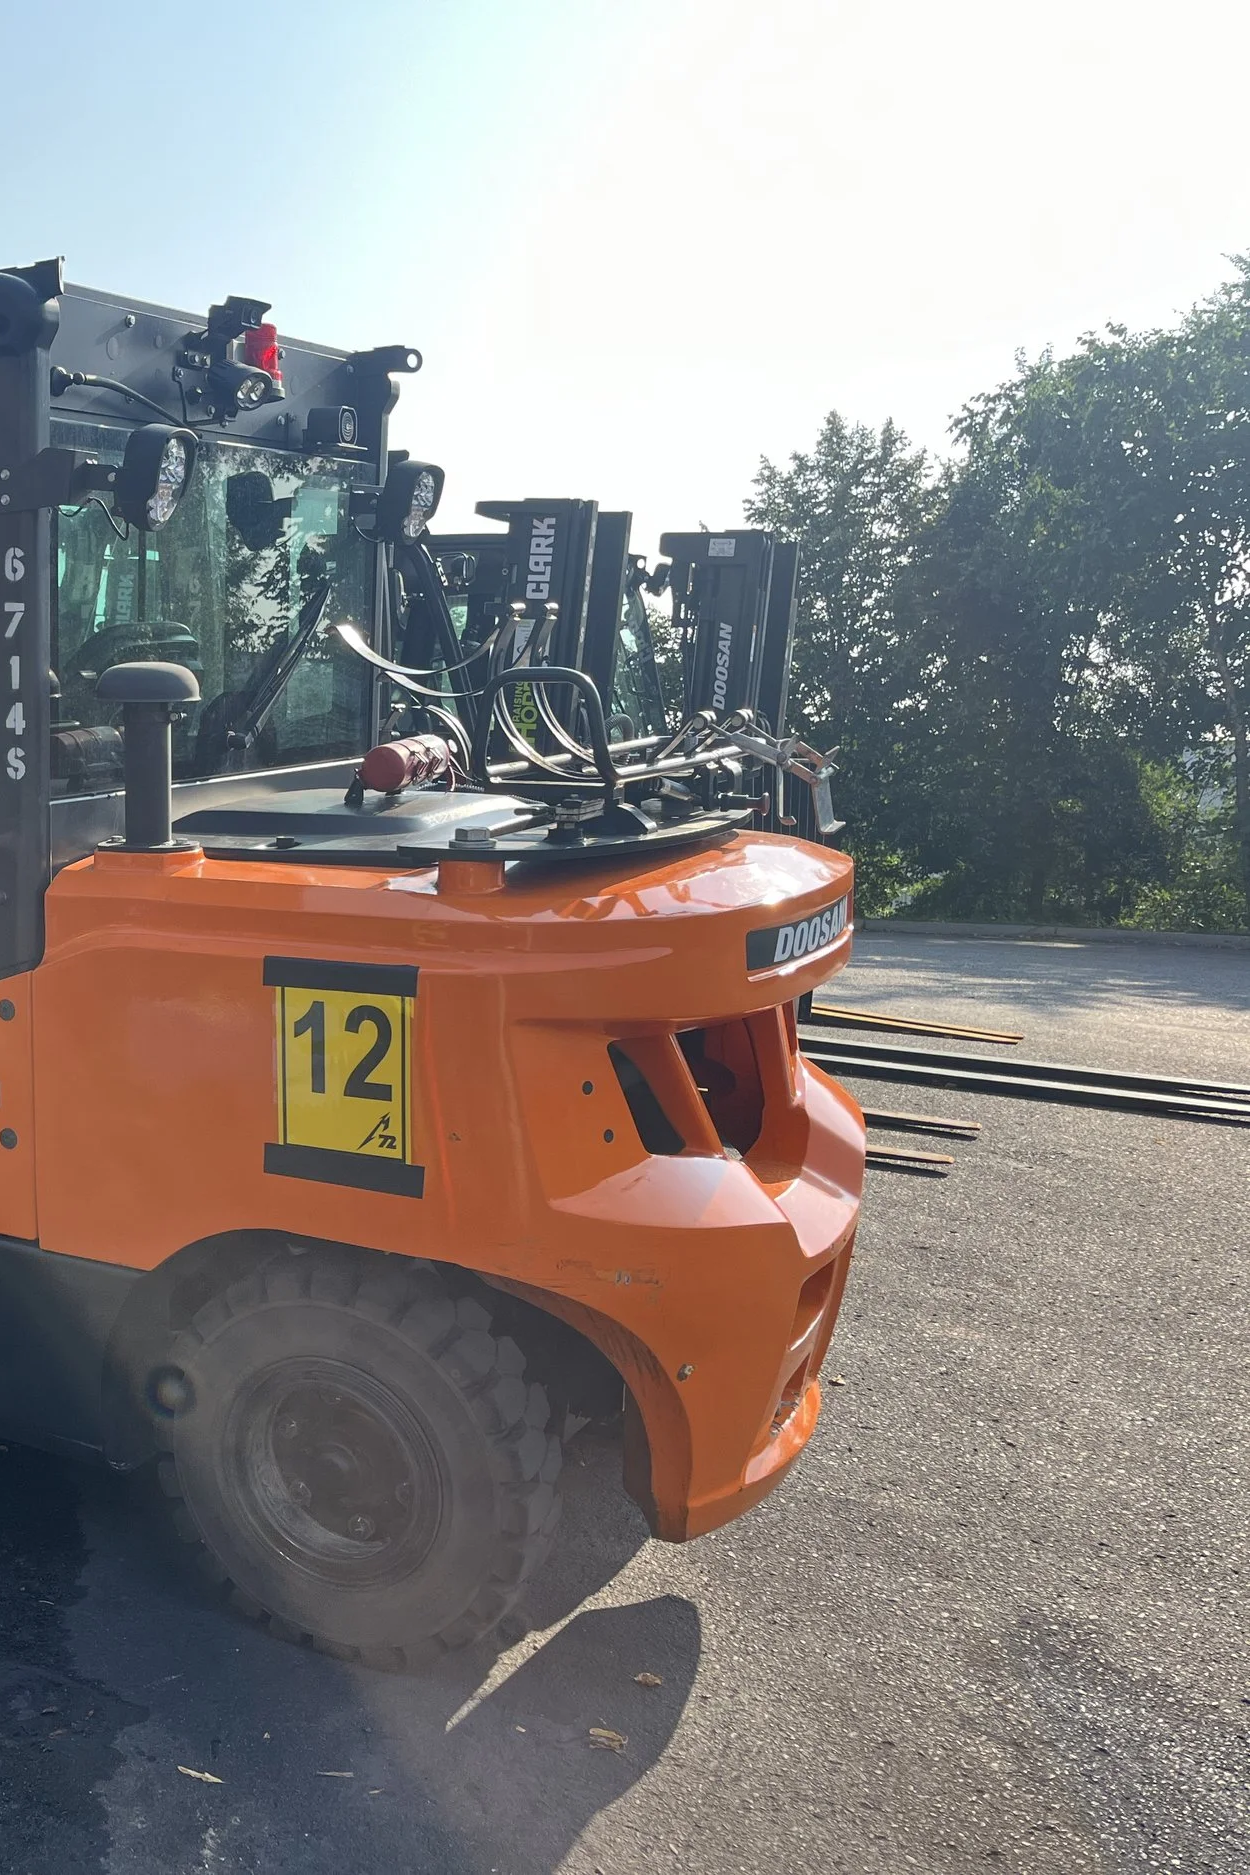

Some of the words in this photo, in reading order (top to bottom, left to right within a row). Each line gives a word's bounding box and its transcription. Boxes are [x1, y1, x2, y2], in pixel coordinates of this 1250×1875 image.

[526, 518, 556, 600] CLARK
[4, 547, 26, 780] 6714S
[713, 622, 733, 710] DOOSAN
[774, 895, 847, 962] DOOSAN
[294, 1001, 393, 1102] 12
